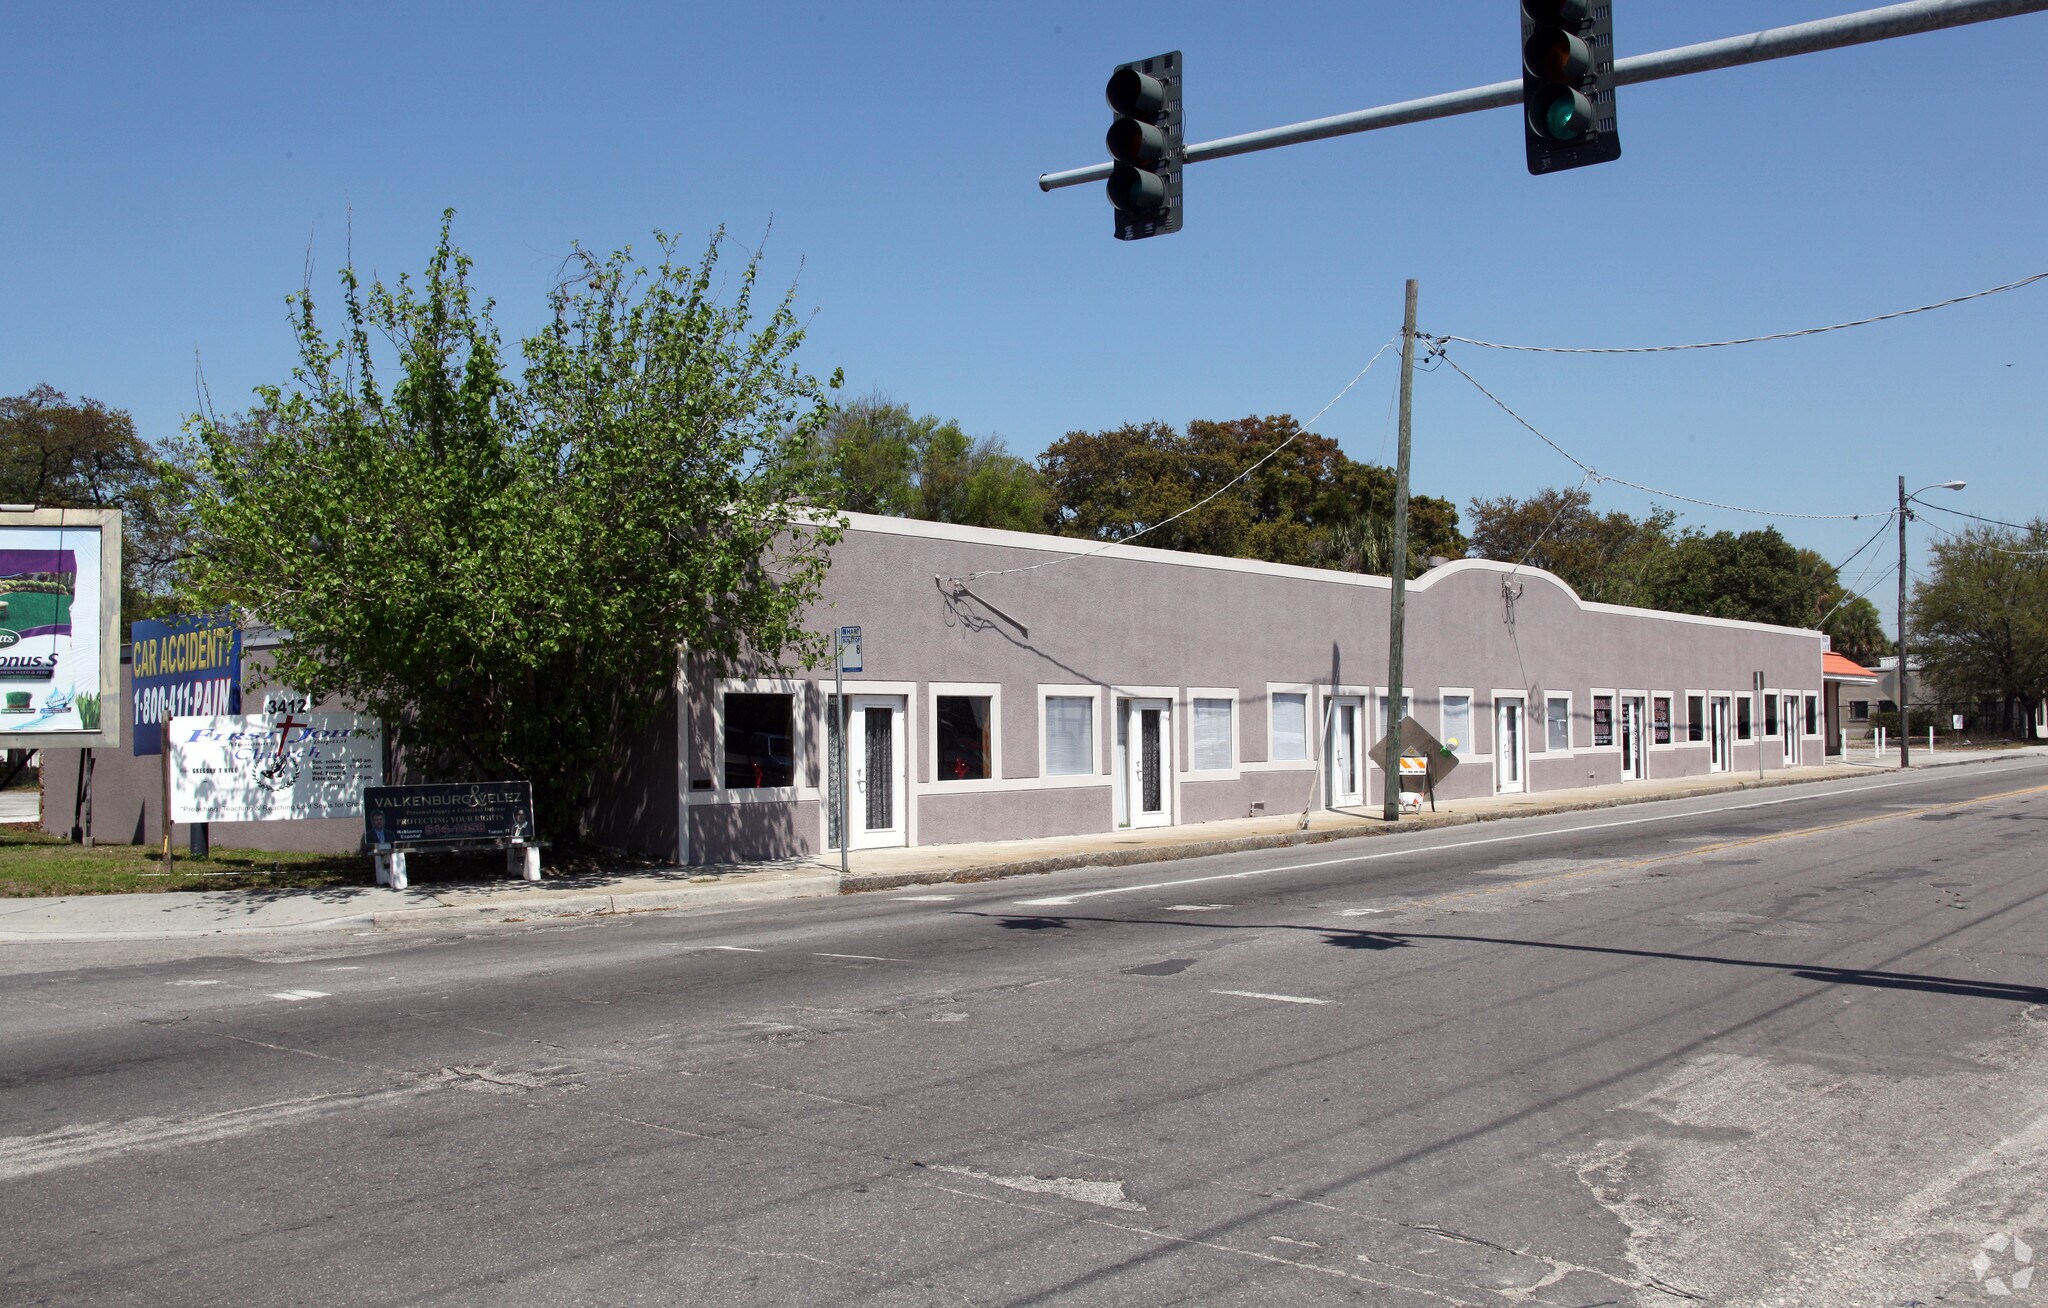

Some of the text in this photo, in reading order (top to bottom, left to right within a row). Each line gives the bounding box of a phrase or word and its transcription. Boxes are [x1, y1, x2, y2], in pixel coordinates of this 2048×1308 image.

[0, 634, 15, 643] tts
[133, 626, 234, 678] CAR ACCIDENT?
[0, 653, 59, 668] onus S
[267, 699, 307, 715] 3412
[374, 794, 472, 808] VALKENBURG
[478, 792, 522, 805] VELEZ
[222, 804, 252, 813] Teaching
[262, 803, 295, 812] Reaching
[396, 814, 505, 825] PROTECTING YOUR RIGHTS
